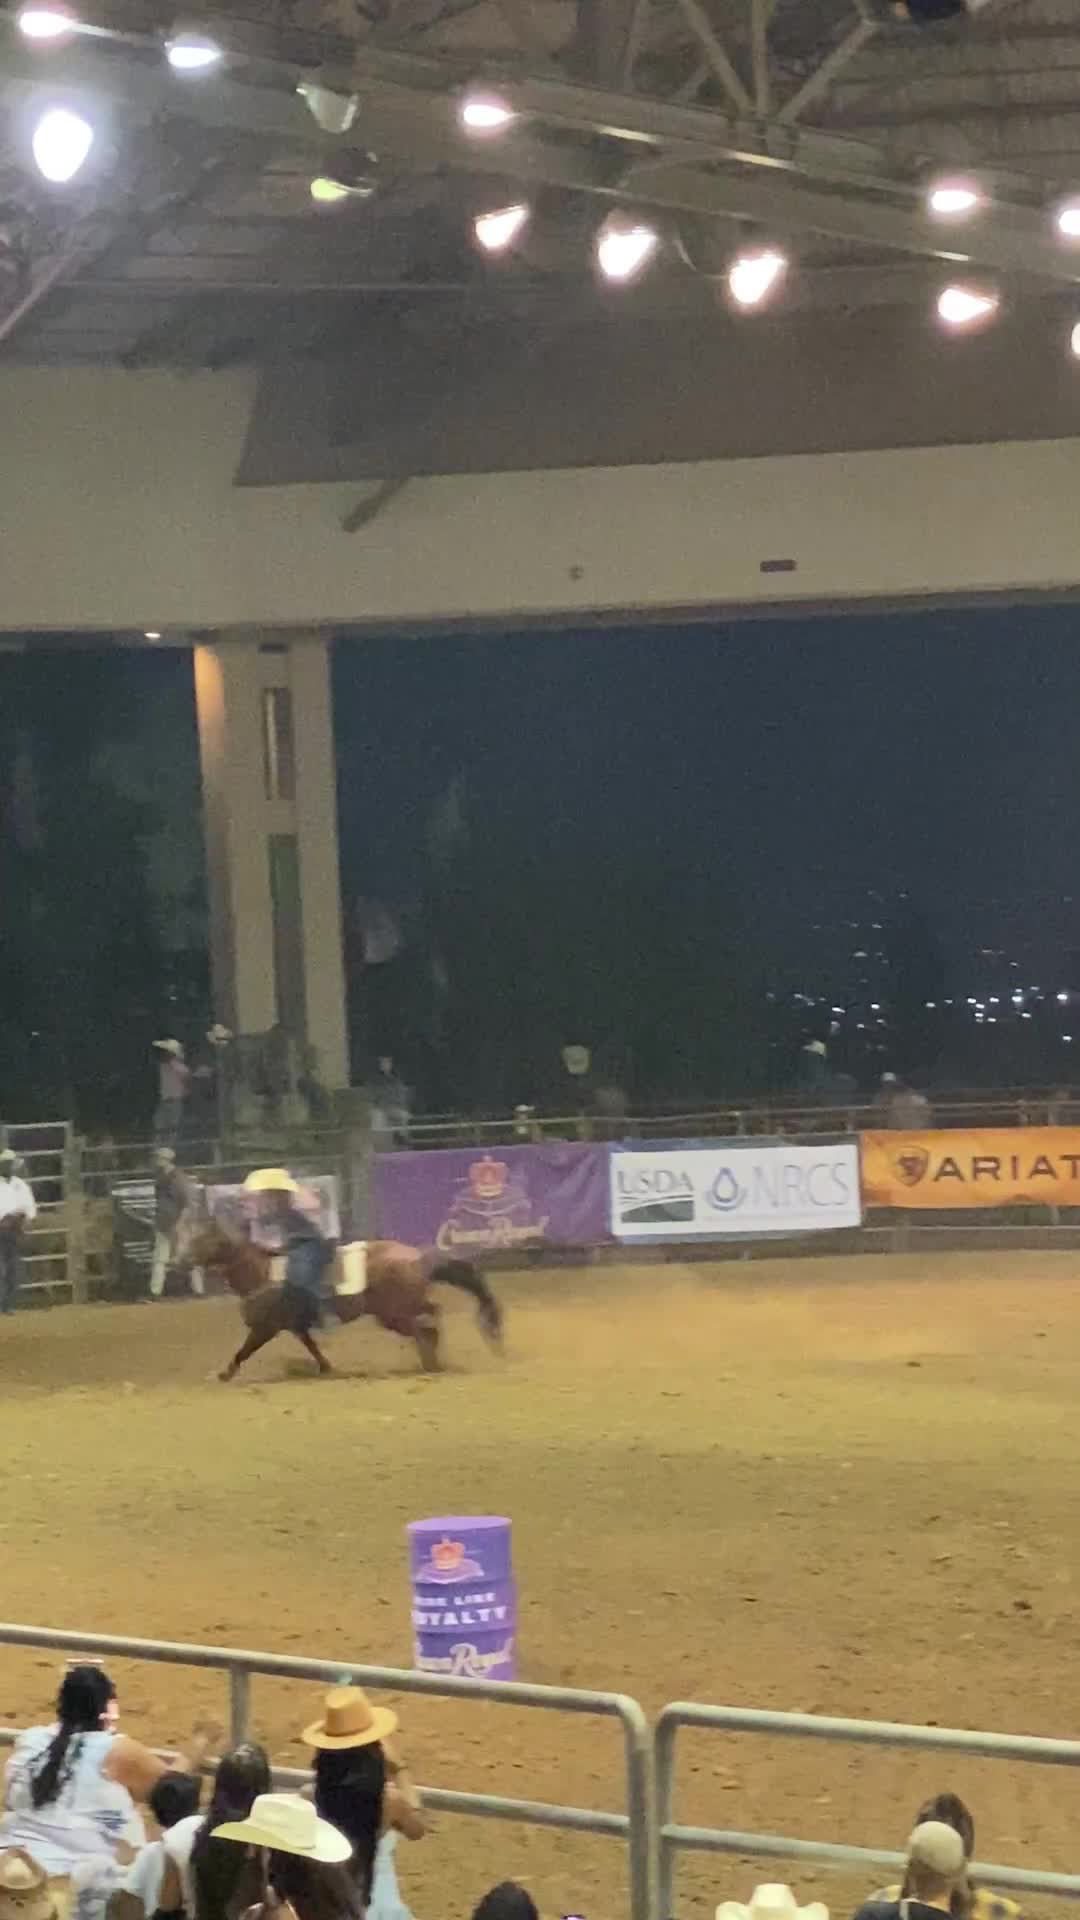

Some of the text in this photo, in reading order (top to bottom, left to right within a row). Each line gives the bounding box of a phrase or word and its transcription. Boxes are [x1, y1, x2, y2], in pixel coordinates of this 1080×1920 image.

[617, 1169, 694, 1194] USDA
[932, 1155, 1080, 1182] ARIAT
[751, 1162, 849, 1208] NRCS
